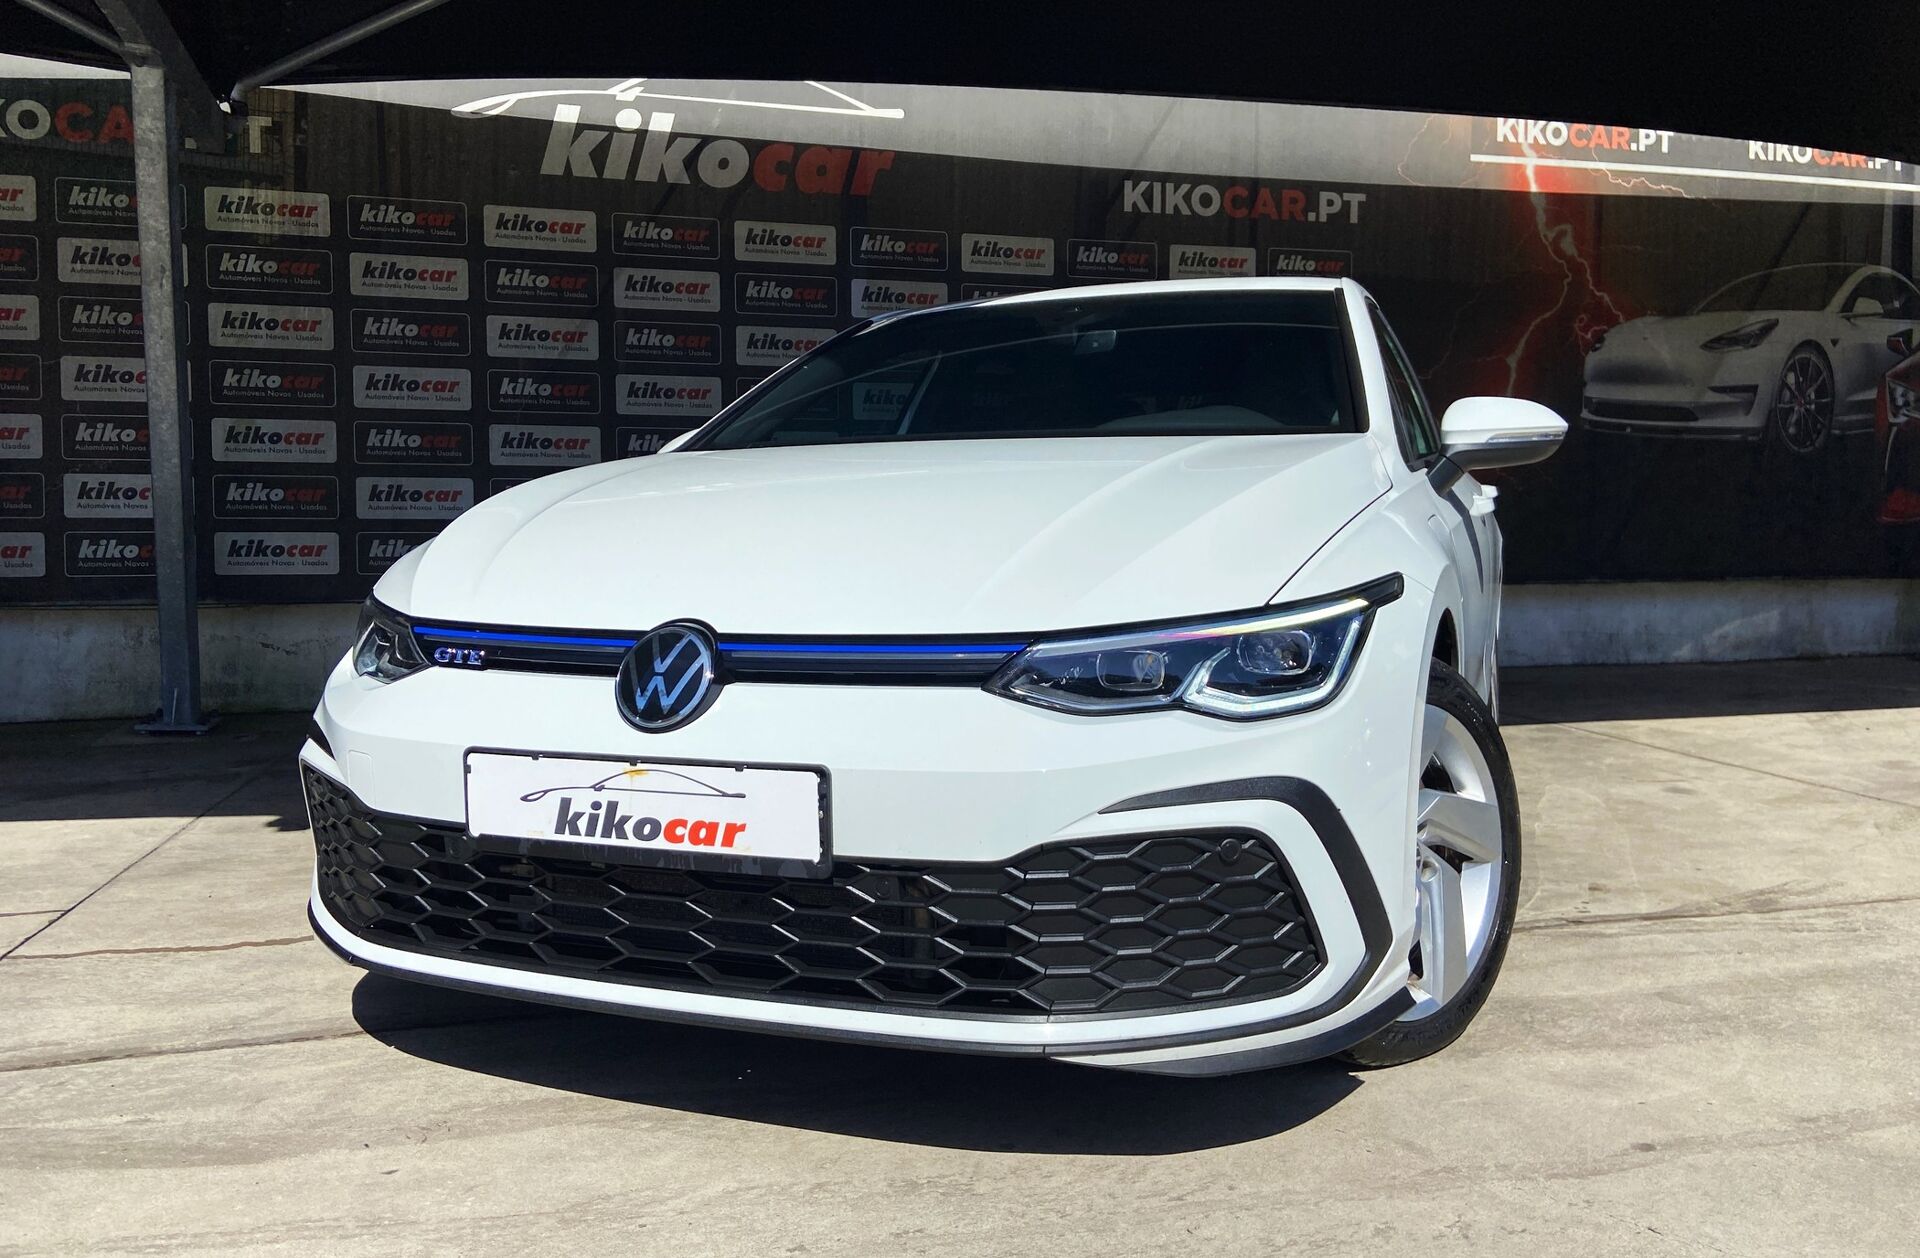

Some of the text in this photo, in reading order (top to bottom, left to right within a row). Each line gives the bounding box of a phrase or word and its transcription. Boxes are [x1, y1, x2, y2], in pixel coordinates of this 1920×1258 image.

[1497, 117, 1674, 153] KIKOCAR.PT
[540, 104, 896, 196] kikocar
[216, 194, 317, 218] kikocar
[1123, 180, 1366, 224] KIKOCAR.PT
[359, 203, 456, 227] kikocar
[495, 212, 586, 235] kikocar
[623, 220, 709, 242] kikocar
[744, 227, 827, 249] kikocar
[860, 233, 938, 255] kikocar
[970, 240, 1045, 260] kikocar
[218, 252, 320, 276] kikocar
[1076, 245, 1148, 265] kikocar
[1178, 250, 1247, 270] kikocar
[1276, 254, 1344, 273] kikocar
[362, 260, 457, 283] kikocar
[496, 267, 587, 289] kikocar
[624, 274, 710, 296] kikocar
[745, 280, 827, 301] kikocar
[860, 285, 939, 306] kikocar
[71, 304, 143, 326] kikoc
[221, 310, 321, 332] kikocar
[363, 316, 459, 338] kikocar
[498, 322, 588, 343] kikocar
[625, 327, 711, 348] kikocar
[746, 332, 821, 352] kikoca
[74, 363, 146, 384] kikoc
[222, 367, 324, 389] kikocar
[365, 373, 460, 393] kikocar
[499, 376, 589, 397] kikocar
[626, 381, 712, 401] kikocar
[75, 421, 148, 442] kikoc
[223, 425, 324, 446] kikocar
[366, 428, 462, 448] kikocar
[500, 431, 590, 450] kikocar
[77, 481, 151, 500] kikoc
[225, 482, 326, 502] kikocar
[368, 484, 463, 503] kikocar
[78, 539, 152, 558] kikoc
[226, 539, 327, 558] kikocar
[434, 647, 485, 665] GTE
[554, 797, 747, 848] kikocar
